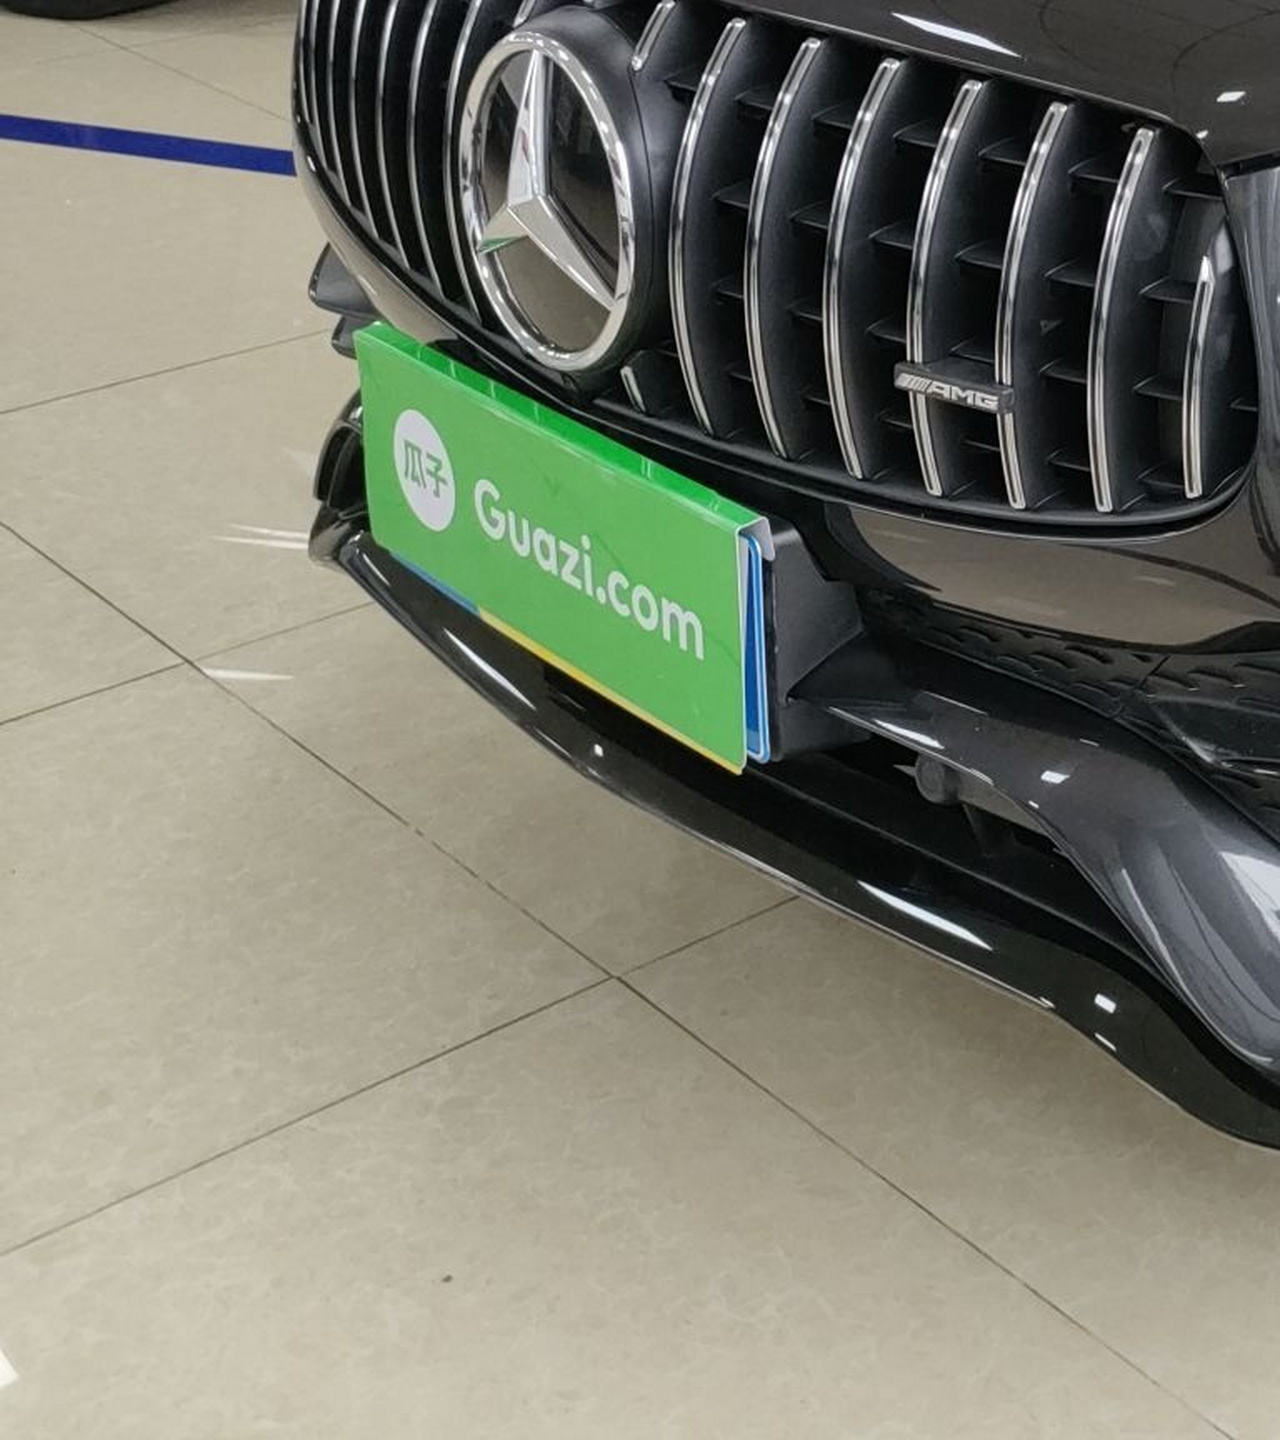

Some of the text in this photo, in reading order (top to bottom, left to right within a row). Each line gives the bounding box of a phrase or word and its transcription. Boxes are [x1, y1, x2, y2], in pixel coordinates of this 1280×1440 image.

[926, 380, 1000, 411] AMG
[403, 440, 448, 498] 瓜子
[474, 478, 705, 661] Guazi.com
